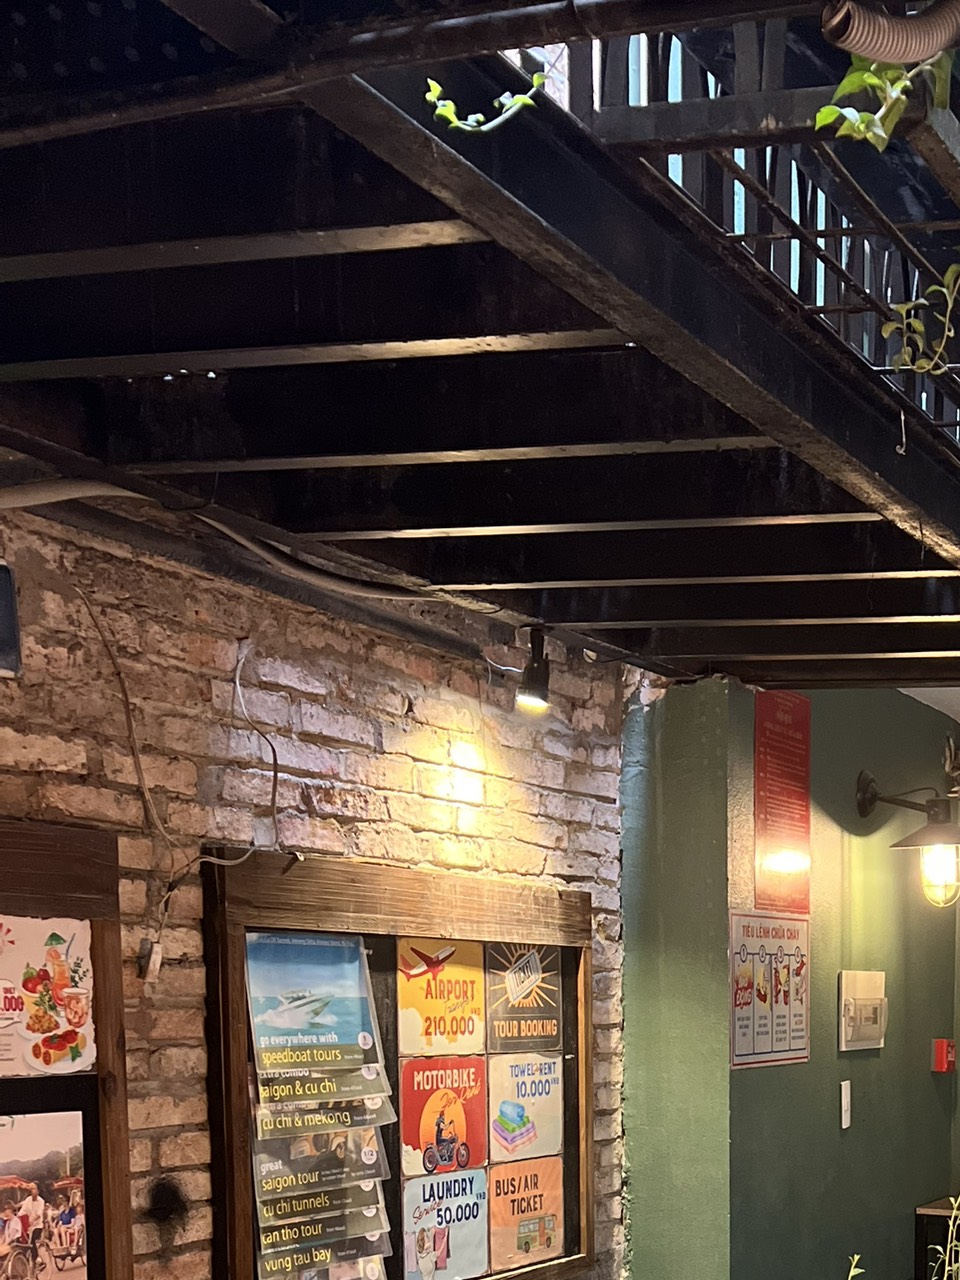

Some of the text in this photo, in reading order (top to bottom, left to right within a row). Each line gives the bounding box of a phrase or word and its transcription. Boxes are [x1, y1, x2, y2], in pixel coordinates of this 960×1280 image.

[425, 979, 475, 1001] AIRPORT
[425, 1016, 475, 1037] 210.000
[493, 1019, 558, 1038] TOUR BOOKING
[260, 1031, 339, 1048] go everywhere with
[262, 1048, 311, 1067] speedboat
[313, 1049, 342, 1061] tours
[413, 1068, 475, 1090] MOTORBIKE
[509, 1063, 535, 1078] TOWEL
[539, 1061, 557, 1076] RENT
[260, 1078, 337, 1100] saigon & cu chi
[516, 1078, 551, 1099] 10.000
[276, 1113, 292, 1128] chi
[294, 1112, 302, 1127] &
[305, 1110, 351, 1126] mekong
[260, 1158, 283, 1175] great
[262, 1174, 296, 1191] saigon
[297, 1170, 320, 1186] tour
[422, 1176, 475, 1203] LAUNDRY
[495, 1173, 539, 1197] BUS/AIR
[263, 1202, 274, 1218] cu
[276, 1198, 291, 1215] chi
[292, 1192, 330, 1211] tunnels
[412, 1199, 444, 1225] Service
[436, 1201, 480, 1226] 50.000
[510, 1193, 545, 1216] TICKET
[262, 1228, 280, 1244] can
[281, 1225, 299, 1241] tho
[301, 1222, 322, 1238] tour
[265, 1256, 292, 1272] vung
[293, 1253, 311, 1266] tau
[312, 1247, 331, 1263] bay
